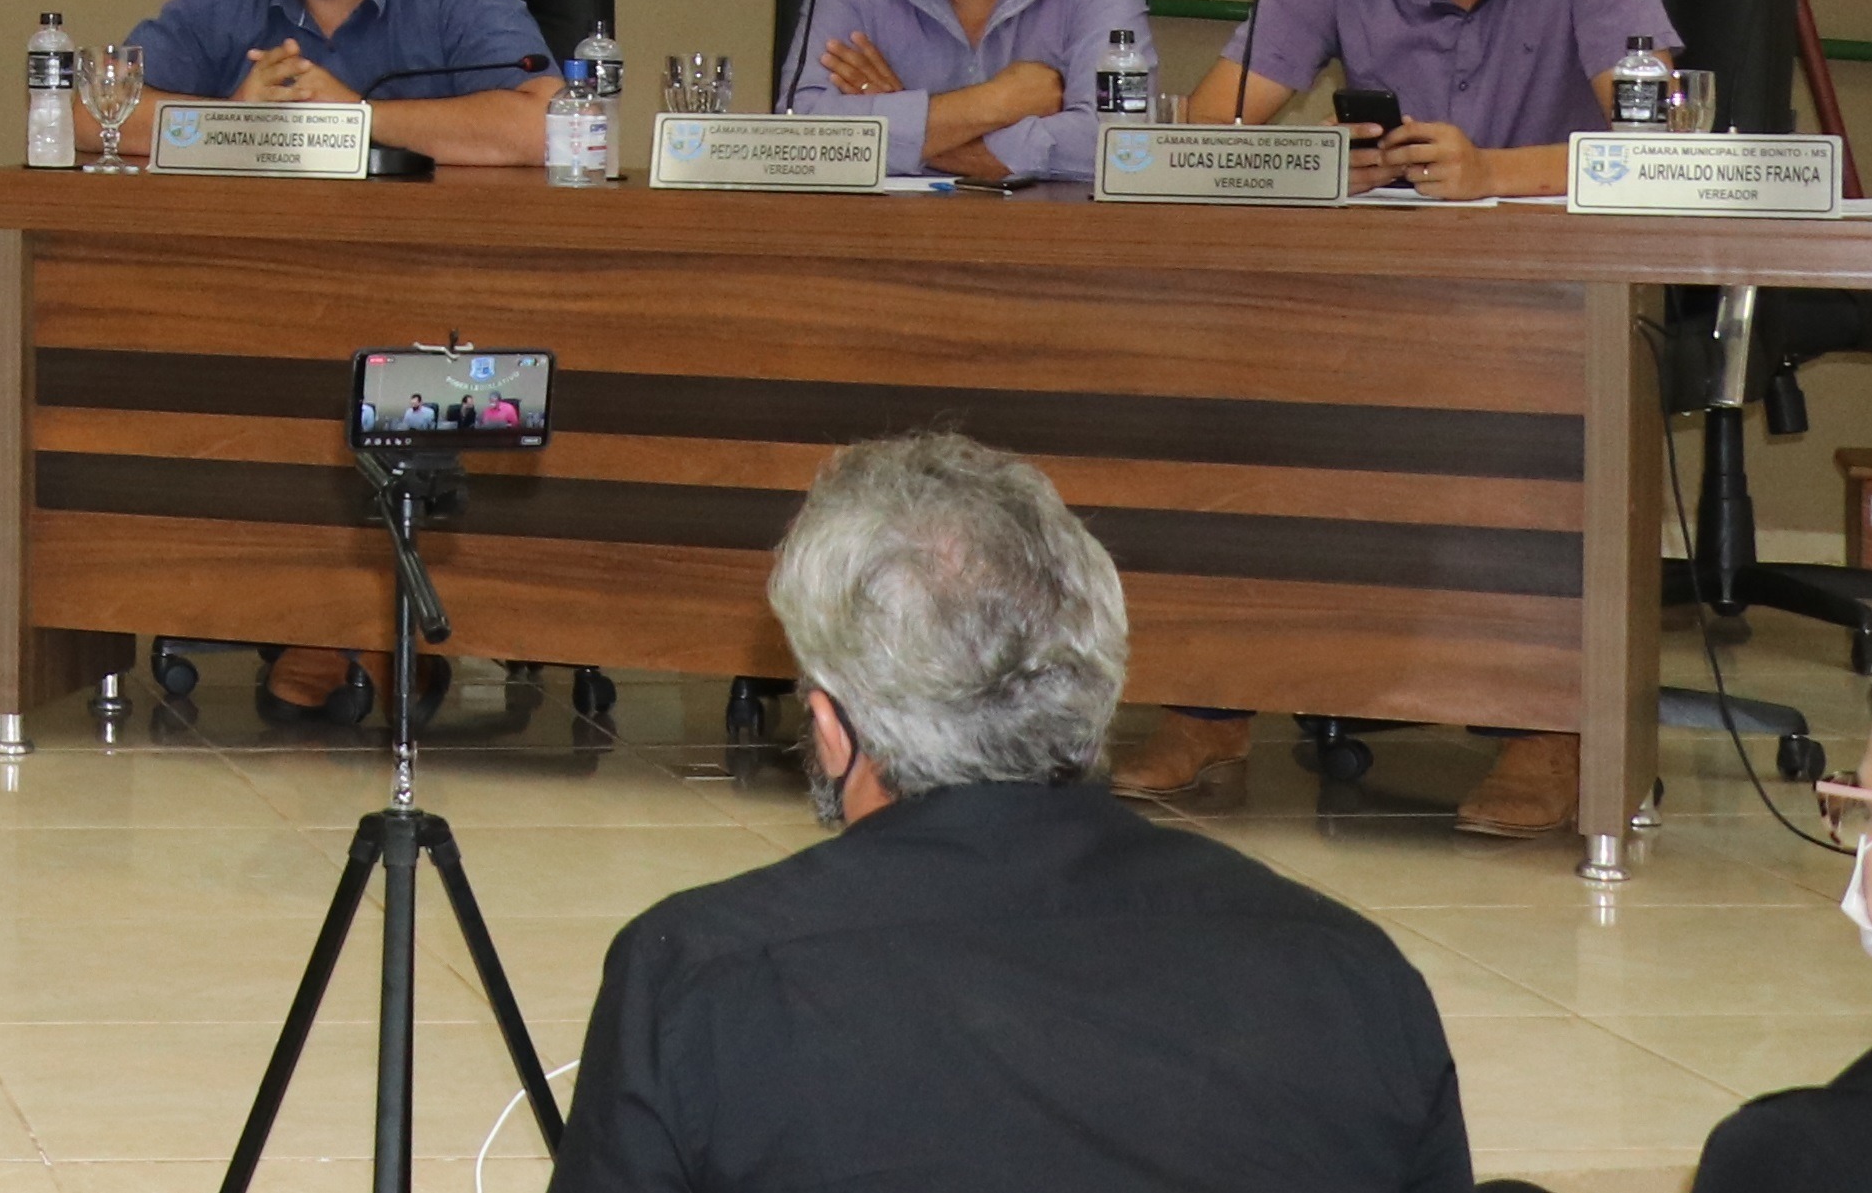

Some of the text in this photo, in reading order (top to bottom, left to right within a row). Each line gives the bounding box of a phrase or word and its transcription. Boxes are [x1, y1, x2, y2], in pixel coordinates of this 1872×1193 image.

[244, 114, 289, 122] MUNICIPAL
[292, 115, 303, 123] DE
[752, 127, 800, 135] MUNICIPAL
[804, 127, 815, 135] DE
[205, 132, 355, 148] JHONATAN JACQUES MARQUES
[1202, 137, 1254, 146] MUNICIPAL
[1258, 138, 1270, 146] DE
[1274, 138, 1312, 147] BONITO
[710, 143, 872, 162] PEDRO APARECIDO ROSÁRIO
[1683, 147, 1738, 156] MUNICIPAL
[1742, 148, 1756, 156] DE
[1760, 148, 1800, 157] BONITO
[1812, 149, 1827, 157] MS
[256, 154, 300, 163] VEREADOR
[1170, 152, 1320, 170] LUCAS LEANDRO PAES
[764, 165, 815, 175] VEREADOR
[1638, 164, 1821, 185] AURIVALDO NUNES FRANÇA
[1214, 178, 1274, 189] VEREADOR
[1698, 189, 1758, 200] VEREADOR
